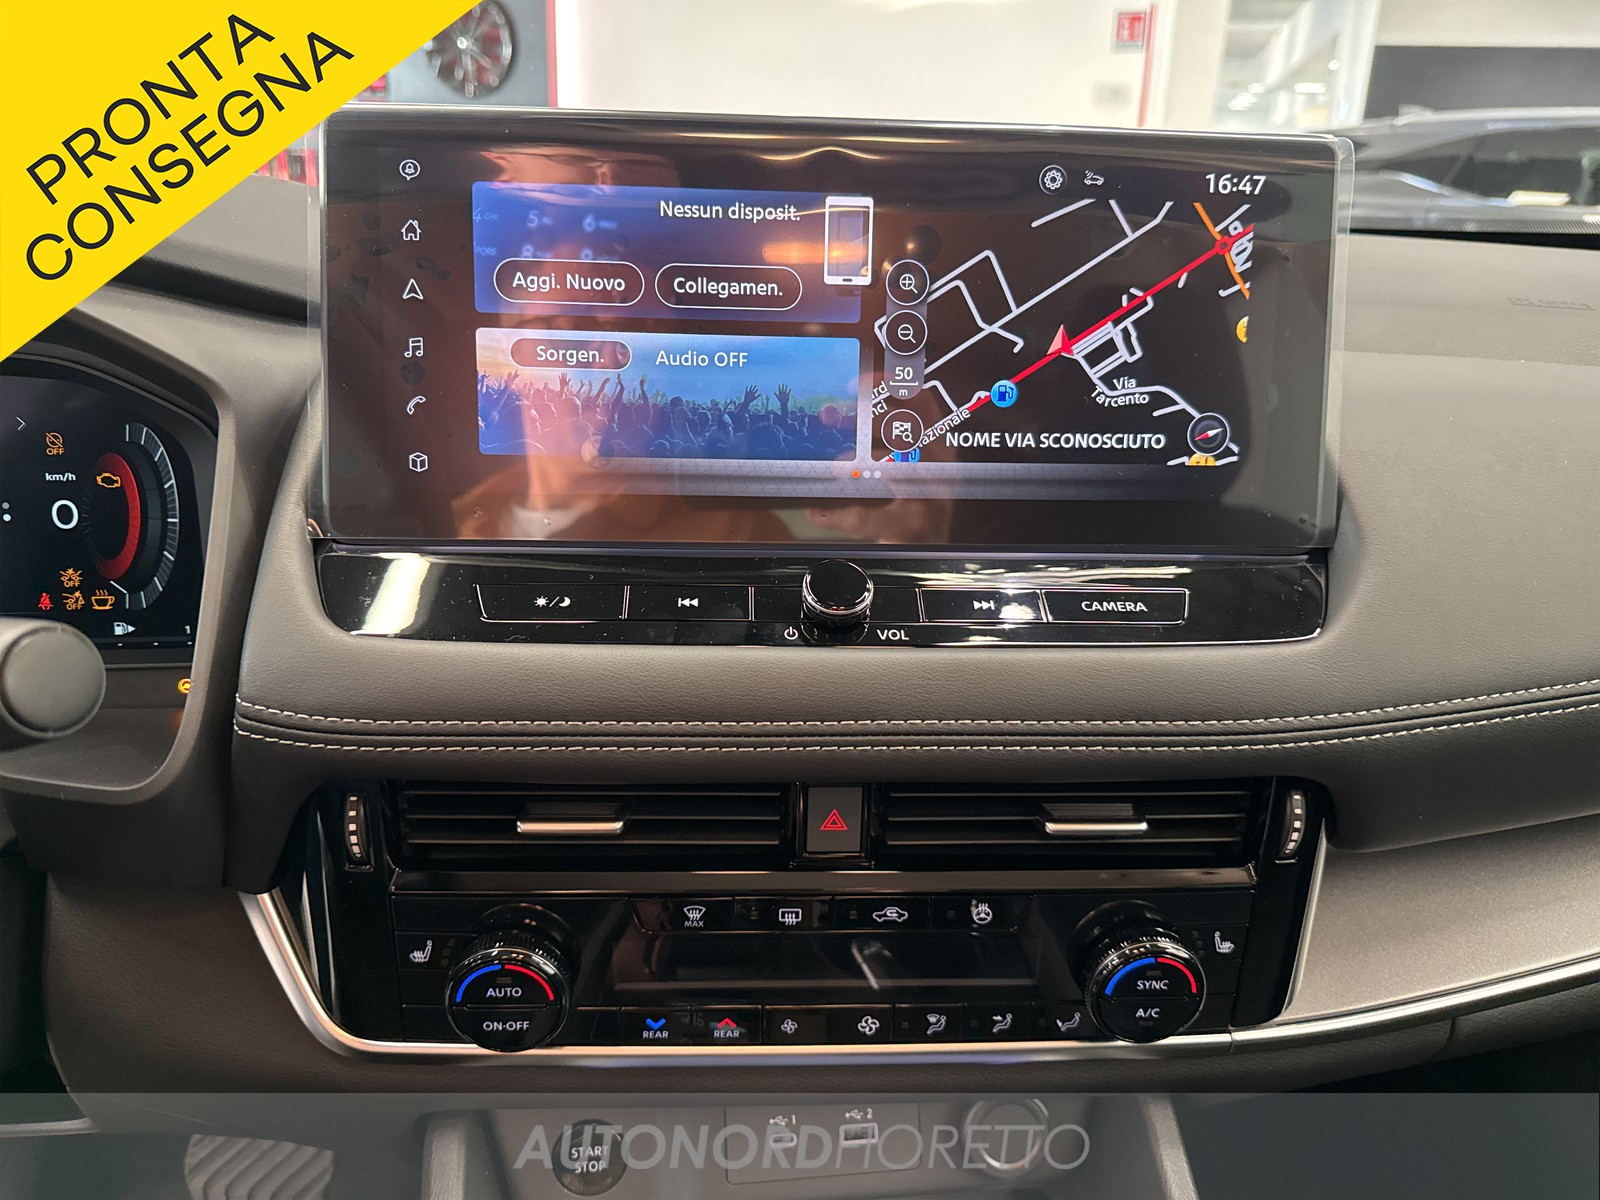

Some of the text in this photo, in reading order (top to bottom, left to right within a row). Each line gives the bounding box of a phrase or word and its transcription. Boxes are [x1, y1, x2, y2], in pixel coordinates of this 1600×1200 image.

[1205, 173, 1267, 195] 16:47
[660, 200, 801, 224] Nessun disposit.
[512, 271, 626, 293] Aggi. Nuovo
[673, 276, 784, 299] Collegamen.
[536, 345, 605, 366] Sorgen.
[655, 350, 748, 368] Audio OFF
[894, 366, 914, 380] 50
[1113, 375, 1137, 391] Via
[898, 388, 909, 397] m
[1090, 386, 1149, 407] Tarcento
[918, 408, 971, 448] azionale
[945, 431, 1166, 450] NOME VIA SCONOSCIUTO
[46, 447, 65, 456] OFF
[45, 472, 77, 483] km/h
[51, 499, 79, 530] 0
[63, 580, 81, 588] OFF
[65, 602, 83, 611] OFF
[1081, 600, 1148, 613] CAMERA
[876, 628, 910, 641] VOL
[684, 919, 705, 928] MAX
[1136, 979, 1170, 990] SYNC
[486, 987, 522, 998] AUTO
[1135, 1008, 1161, 1018] A/C
[643, 1030, 669, 1039] REAR
[713, 1030, 740, 1038] REAR
[791, 1114, 796, 1125] 1
[866, 1107, 873, 1119] 2
[571, 1145, 610, 1159] START
[574, 1160, 609, 1174] STOP
